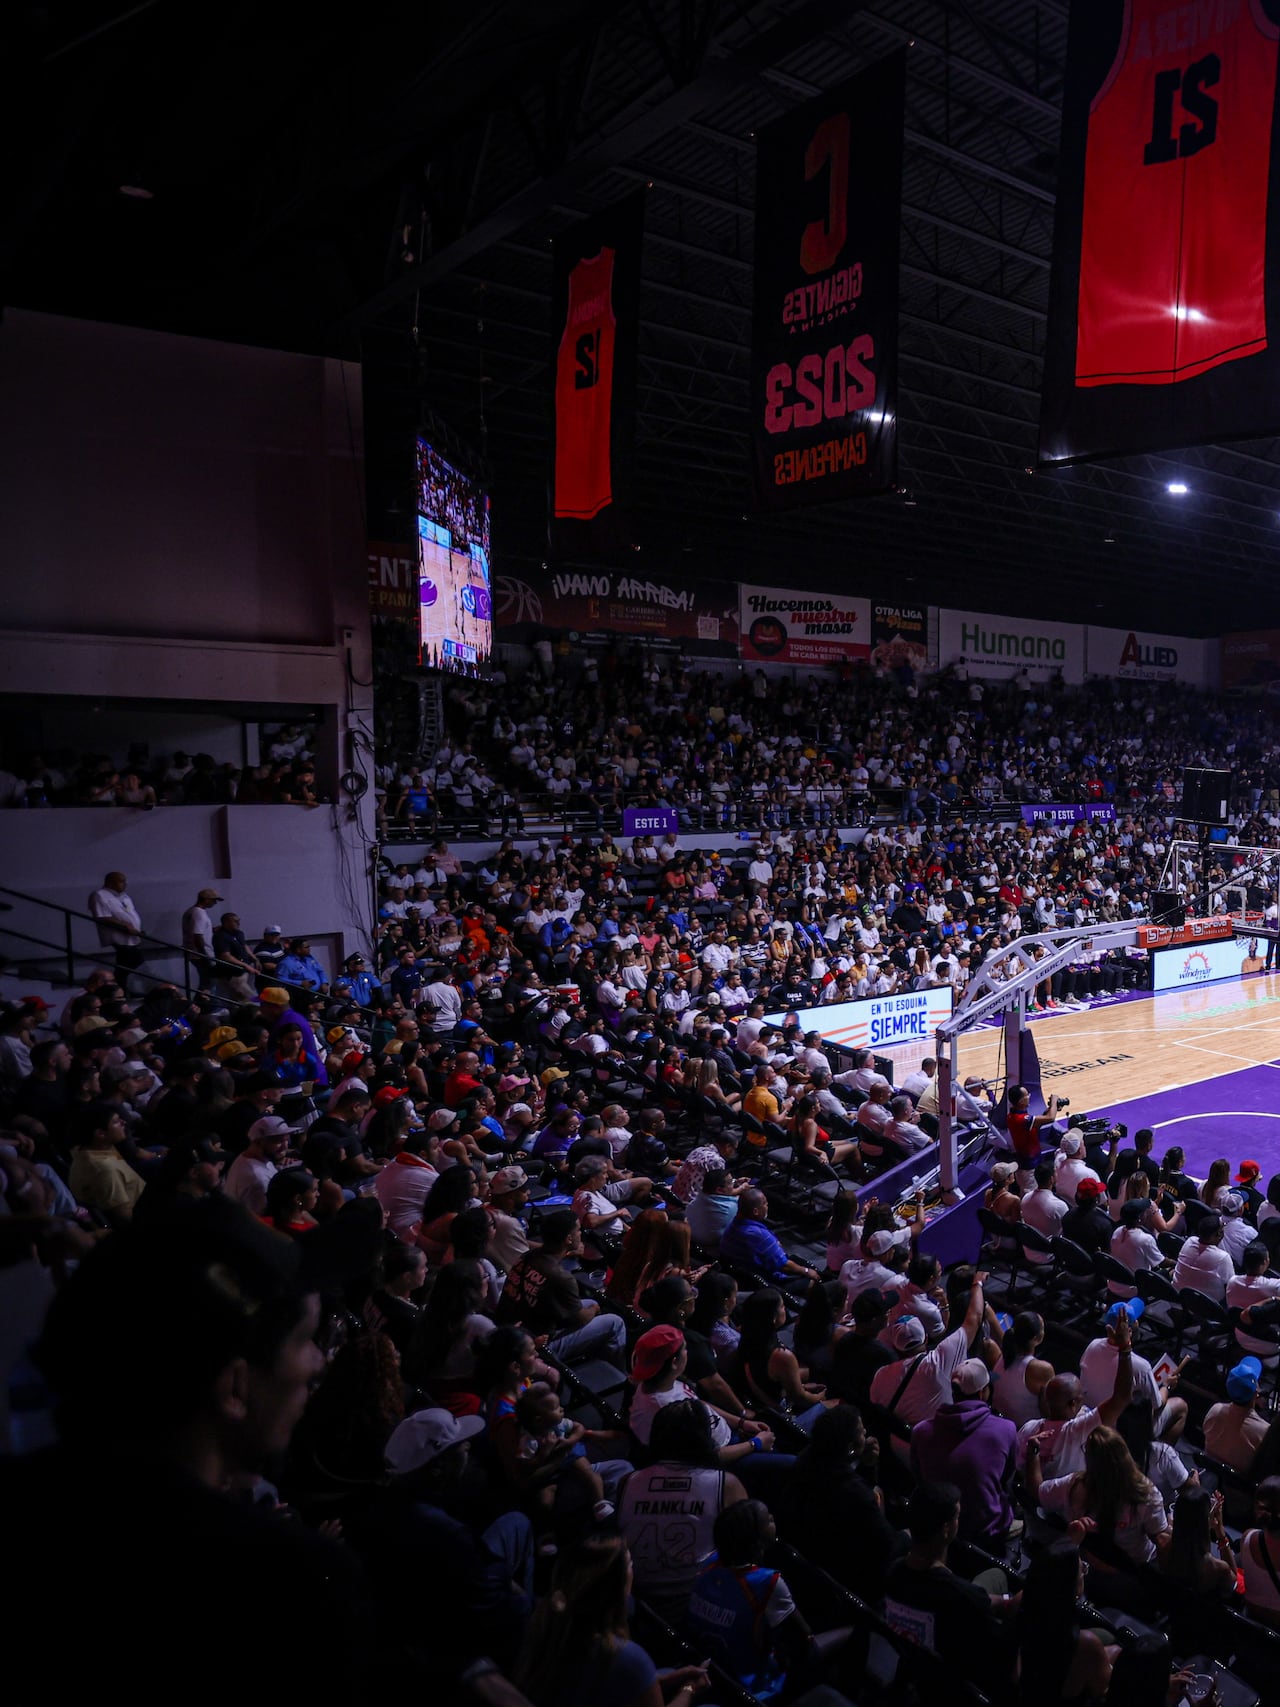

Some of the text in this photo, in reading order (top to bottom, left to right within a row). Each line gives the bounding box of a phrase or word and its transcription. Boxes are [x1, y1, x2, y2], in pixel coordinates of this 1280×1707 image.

[747, 595, 834, 613] Hacemos
[791, 608, 857, 624] nuestra
[875, 606, 923, 620] OTRA LIGA
[804, 622, 853, 635] masa
[961, 622, 1065, 660] Humana
[1119, 632, 1178, 668] ALLIED
[634, 817, 668, 829] ESTE 1
[1033, 810, 1075, 820] PALO ESTE
[871, 996, 928, 1015] EN TU ESQUINA
[871, 1011, 928, 1043] SIEMPRE
[634, 1500, 705, 1516] FRANKLIN
[634, 1522, 697, 1566] 42
